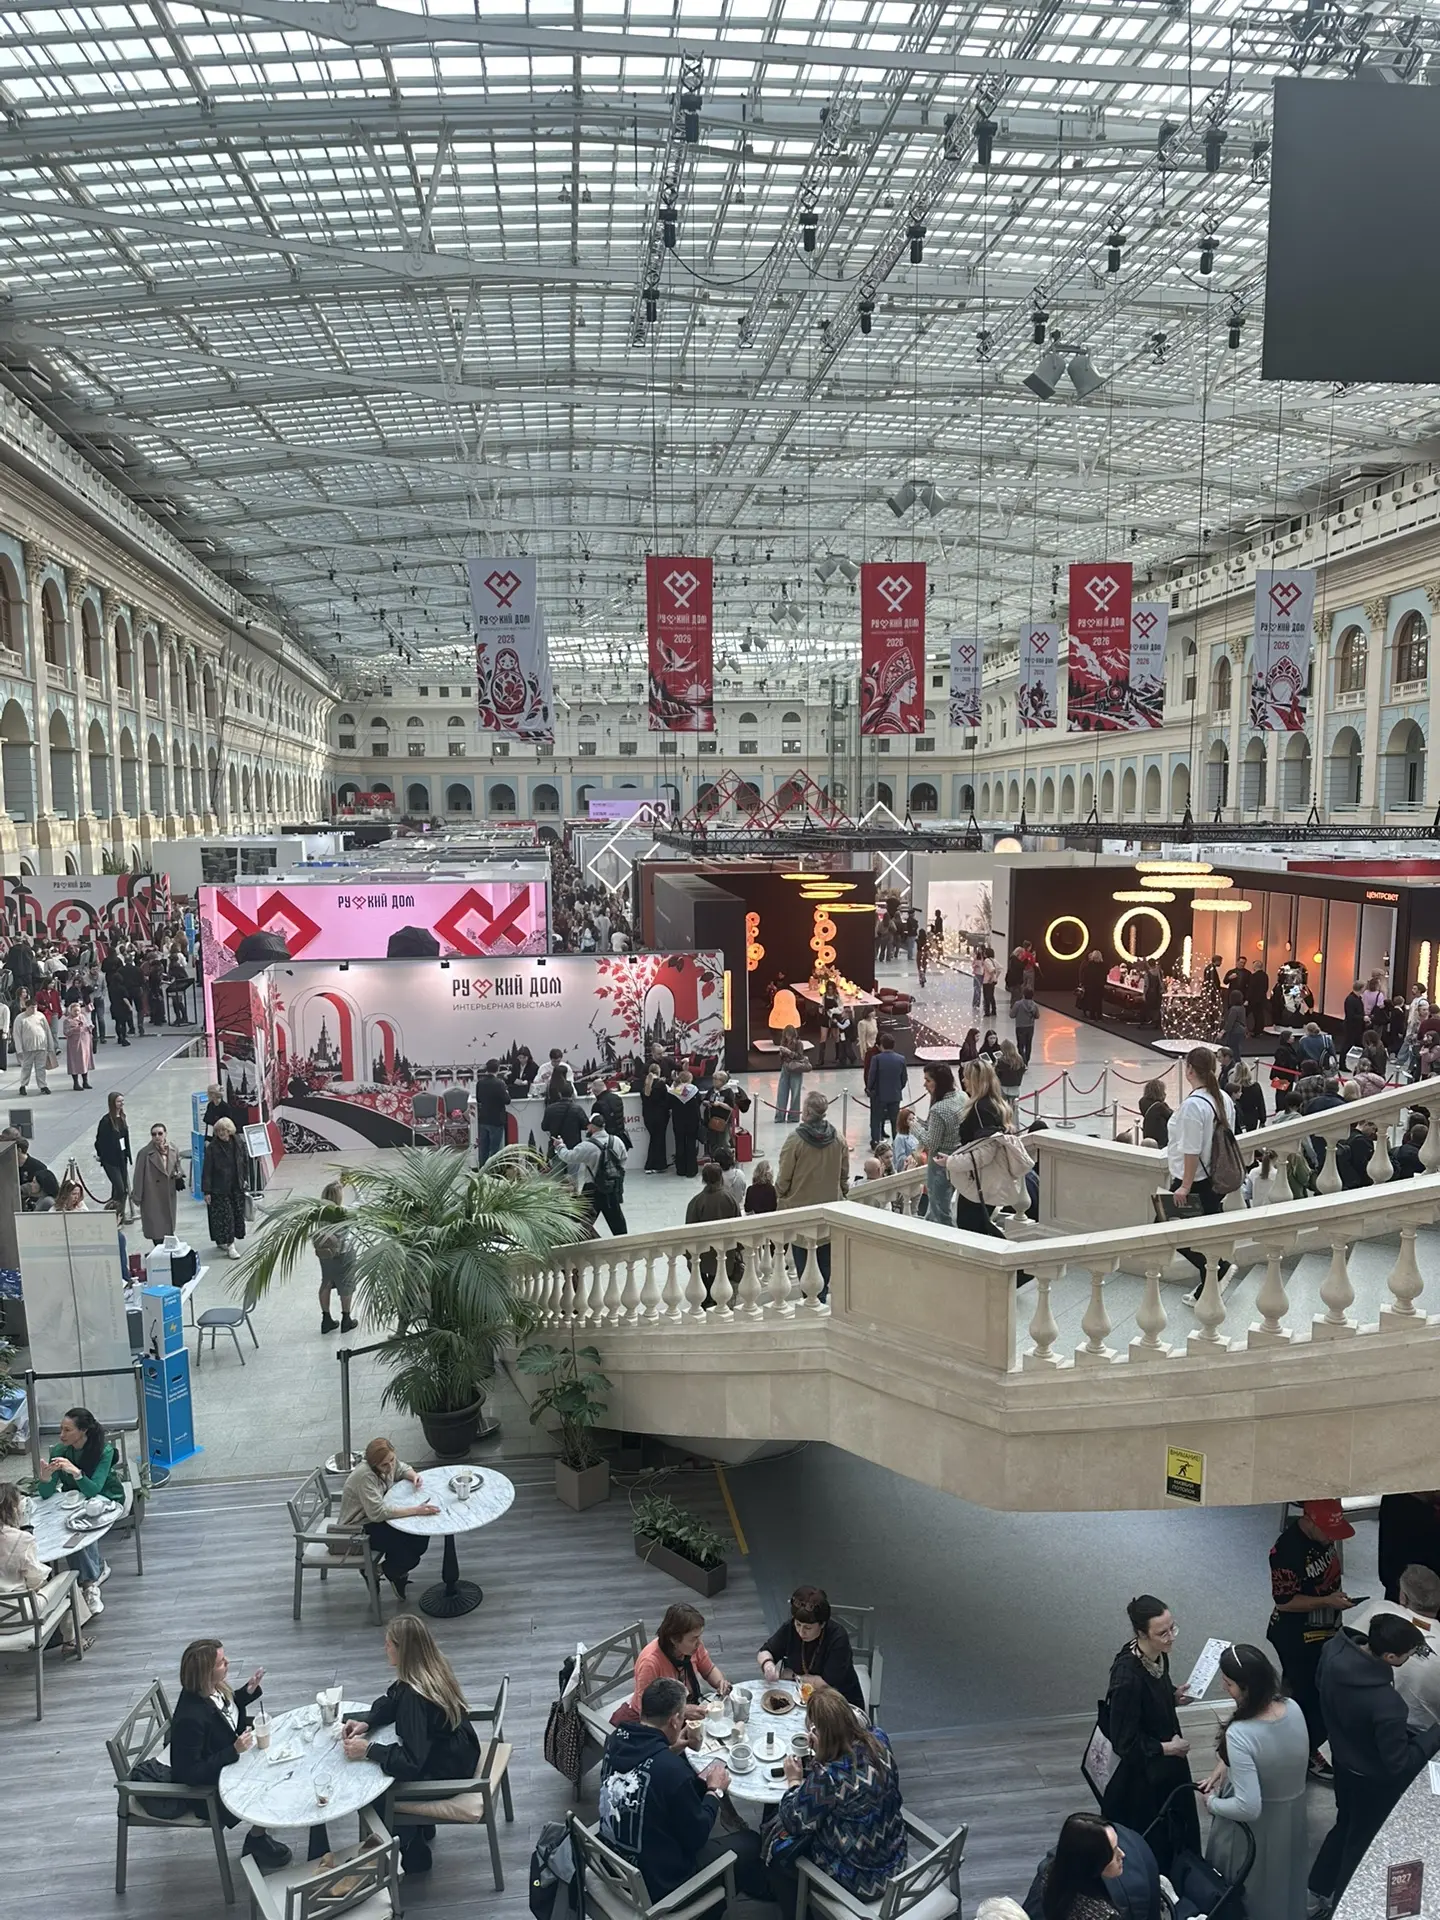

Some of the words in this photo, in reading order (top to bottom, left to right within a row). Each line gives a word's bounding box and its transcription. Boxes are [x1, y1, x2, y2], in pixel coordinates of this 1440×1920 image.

[673, 634, 692, 644] 2026
[886, 637, 904, 647] 2026
[1273, 641, 1290, 650] 2026
[391, 894, 415, 909] ДОМ
[529, 976, 562, 998] ДОМ
[452, 1002, 515, 1011] ИНТЕРЬЕРНАЯ
[516, 1000, 562, 1010] ВЫСТАВКА
[1391, 1873, 1412, 1885] 2027
